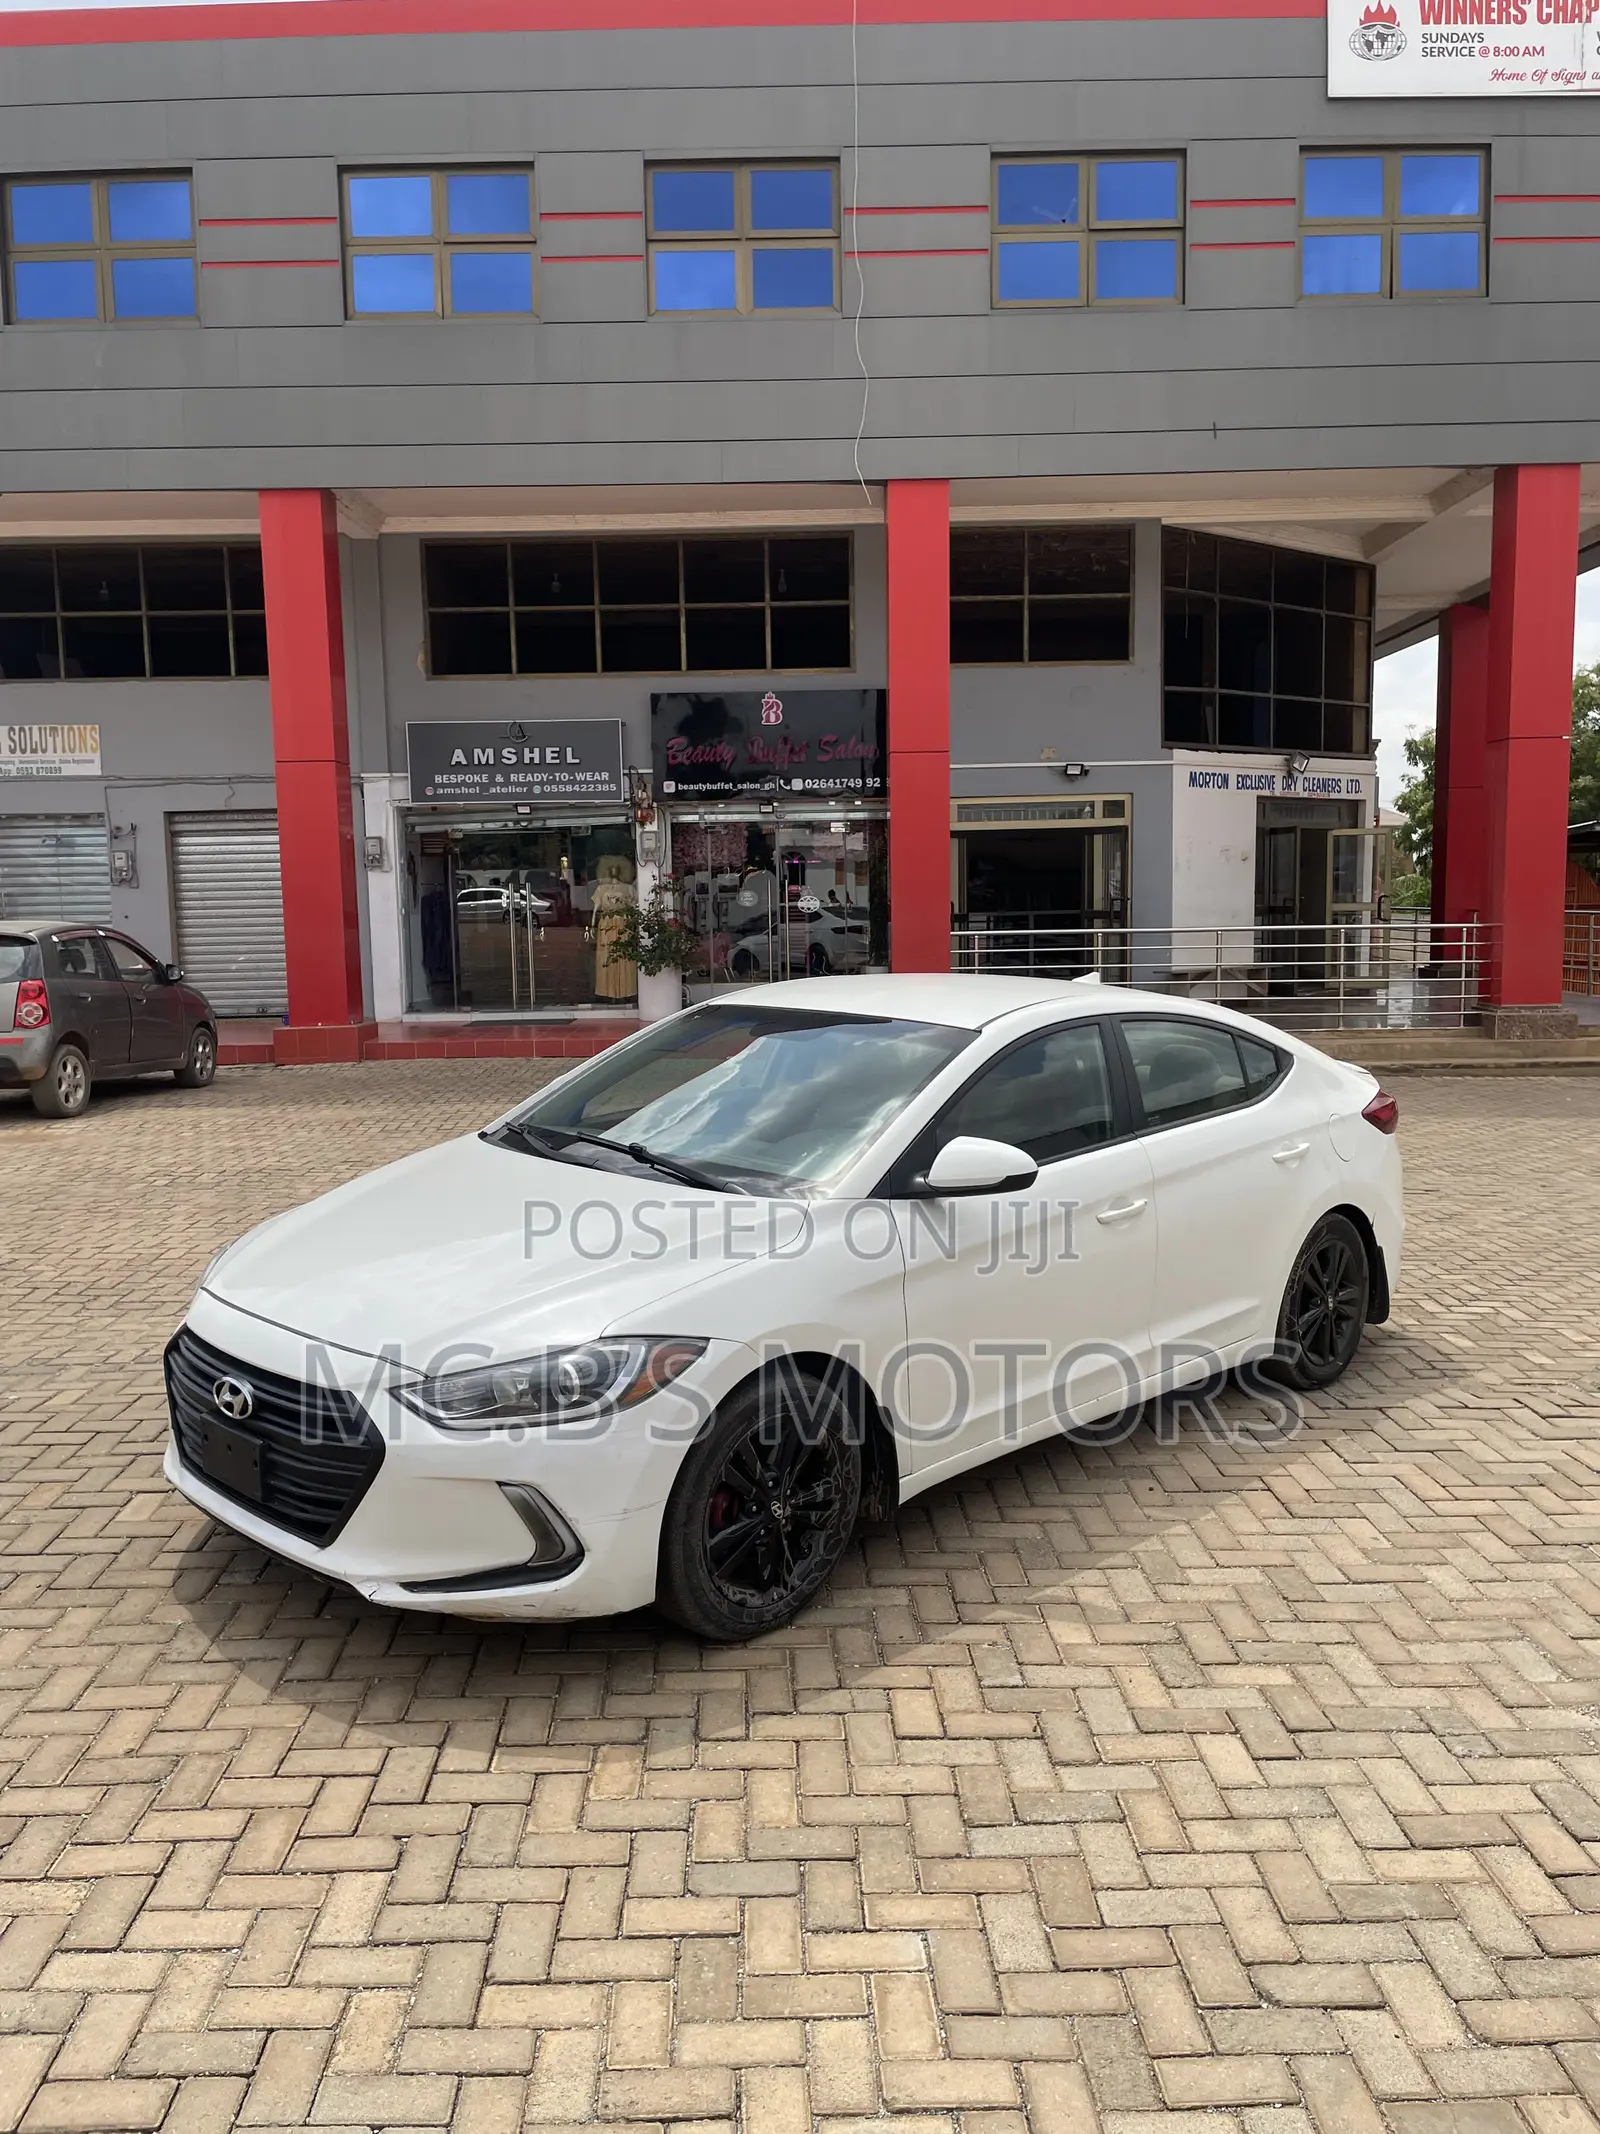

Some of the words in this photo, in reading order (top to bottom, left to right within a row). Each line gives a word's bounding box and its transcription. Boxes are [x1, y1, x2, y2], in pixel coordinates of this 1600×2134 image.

[1419, 0, 1532, 26] WINNERS'
[1421, 32, 1485, 44] SUNDAYS
[1421, 46, 1476, 58] SERVICE
[1478, 46, 1490, 58] @
[1493, 46, 1520, 57] 8:00
[1521, 46, 1545, 57] AM
[1488, 67, 1528, 83] Home
[1531, 68, 1549, 85] Of
[1550, 68, 1587, 86] Signs
[8, 726, 99, 755] SOLUTIONS
[450, 746, 580, 766] AMSHEL
[666, 736, 737, 772] Beauty
[816, 734, 879, 763] Salon
[434, 774, 489, 784] BESPOKE
[495, 773, 505, 783] &
[510, 772, 610, 783] READY-TO-WEAR
[677, 781, 776, 792] beautybuffet_salon_gh
[804, 778, 863, 790] 02641749
[866, 777, 881, 788] 92
[1188, 771, 1230, 790] MORTON
[1236, 774, 1276, 791] EXCLUSIVE
[1281, 775, 1299, 792] DRY
[1303, 777, 1342, 794] CLEANERS
[1346, 779, 1362, 794] LTD.
[436, 786, 480, 795] amshel
[543, 783, 617, 793] 0558422385
